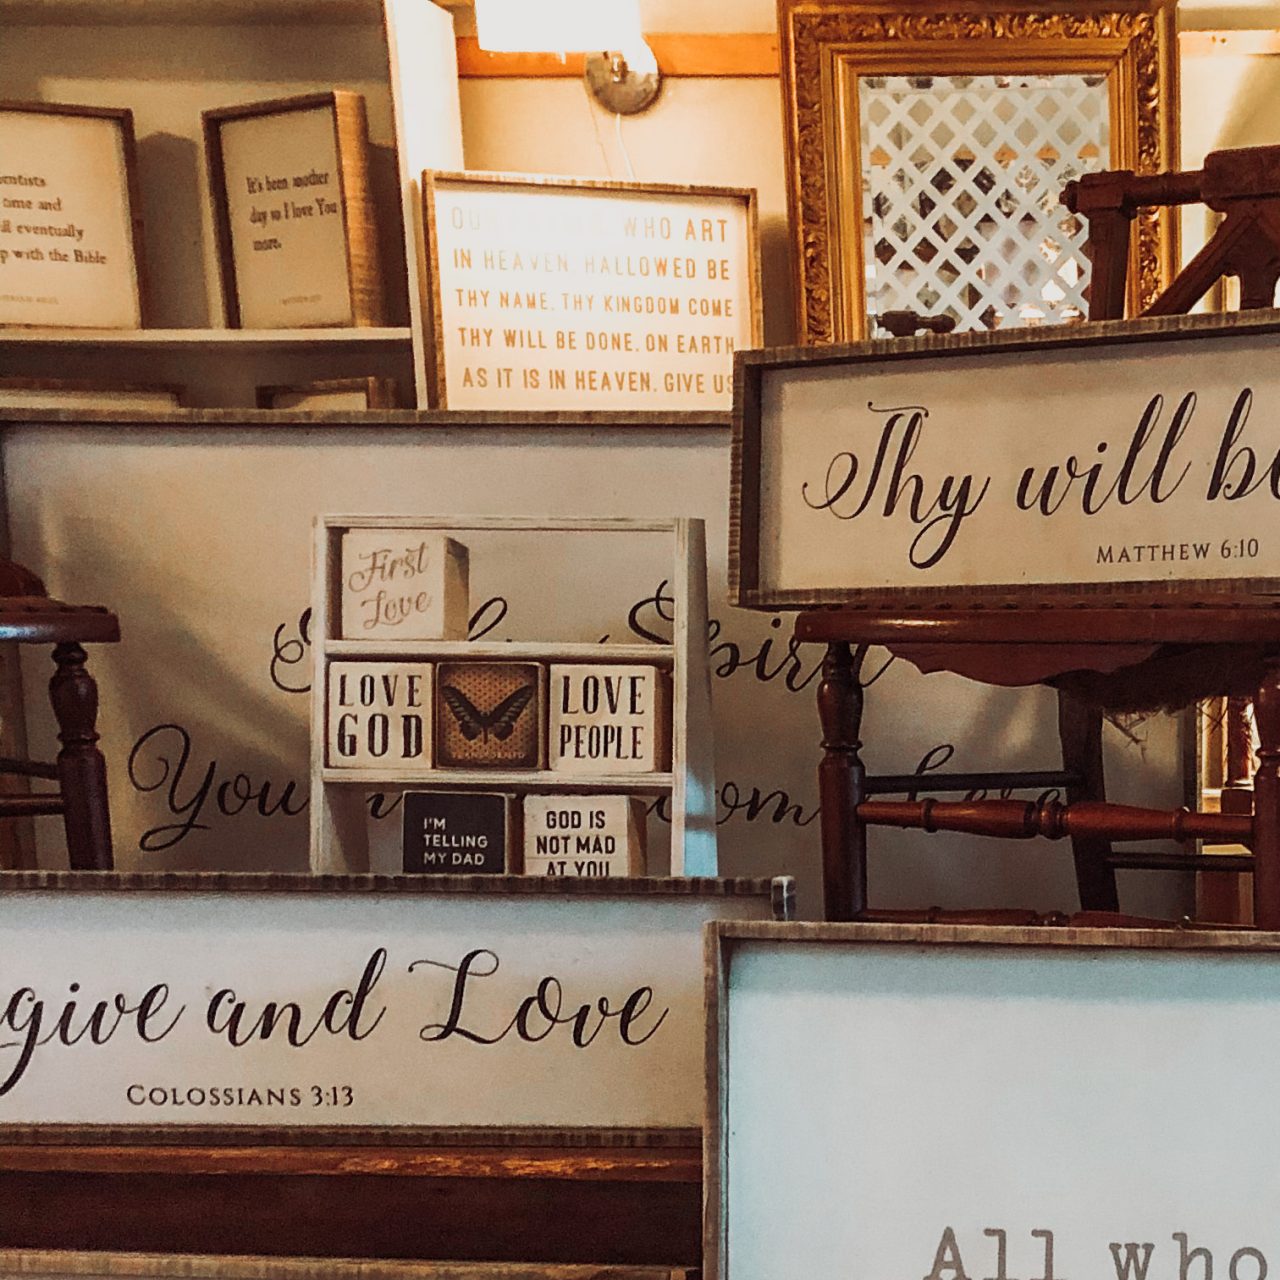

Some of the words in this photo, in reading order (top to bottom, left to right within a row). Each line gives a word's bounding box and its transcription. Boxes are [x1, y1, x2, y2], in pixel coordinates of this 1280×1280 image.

[265, 173, 289, 191] been
[292, 170, 330, 188] another
[250, 206, 268, 225] day
[291, 202, 313, 218] love
[315, 198, 338, 216] You
[685, 218, 728, 243] ART
[48, 249, 69, 262] the
[73, 249, 107, 264] Bible
[453, 248, 472, 270] IN
[585, 253, 696, 279] HALLOWED
[707, 259, 730, 280] BE
[455, 289, 490, 308] THY
[562, 293, 594, 312] THY
[604, 295, 679, 315] KINGDOM
[688, 298, 733, 317] COME
[458, 327, 493, 347] THY
[503, 329, 547, 349] WILL
[556, 330, 577, 350] BE
[646, 333, 668, 354] ON
[677, 335, 735, 355] EARTH
[462, 368, 488, 389] AS
[497, 368, 513, 389] IT
[522, 369, 540, 390] IS
[549, 369, 565, 390] IN
[664, 372, 705, 394] GIVE
[803, 401, 992, 569] Thy
[1015, 391, 1200, 515] will
[1219, 539, 1260, 560] 6:10
[348, 540, 430, 597] First
[360, 588, 432, 631] Love
[339, 672, 423, 708] LOVE
[562, 673, 646, 716] LOVE
[337, 714, 423, 758] GOD
[559, 723, 644, 760] PEOPLE
[423, 817, 446, 831] I'M
[545, 811, 580, 830] GOD
[588, 811, 605, 830] IS
[423, 834, 488, 849] TELLING
[535, 836, 570, 855] NOT
[576, 836, 616, 855] MAD
[423, 853, 447, 866] MY
[453, 853, 484, 866] DAD
[206, 948, 388, 1047] and
[408, 949, 668, 1048] Love
[312, 1085, 355, 1106] 3:13
